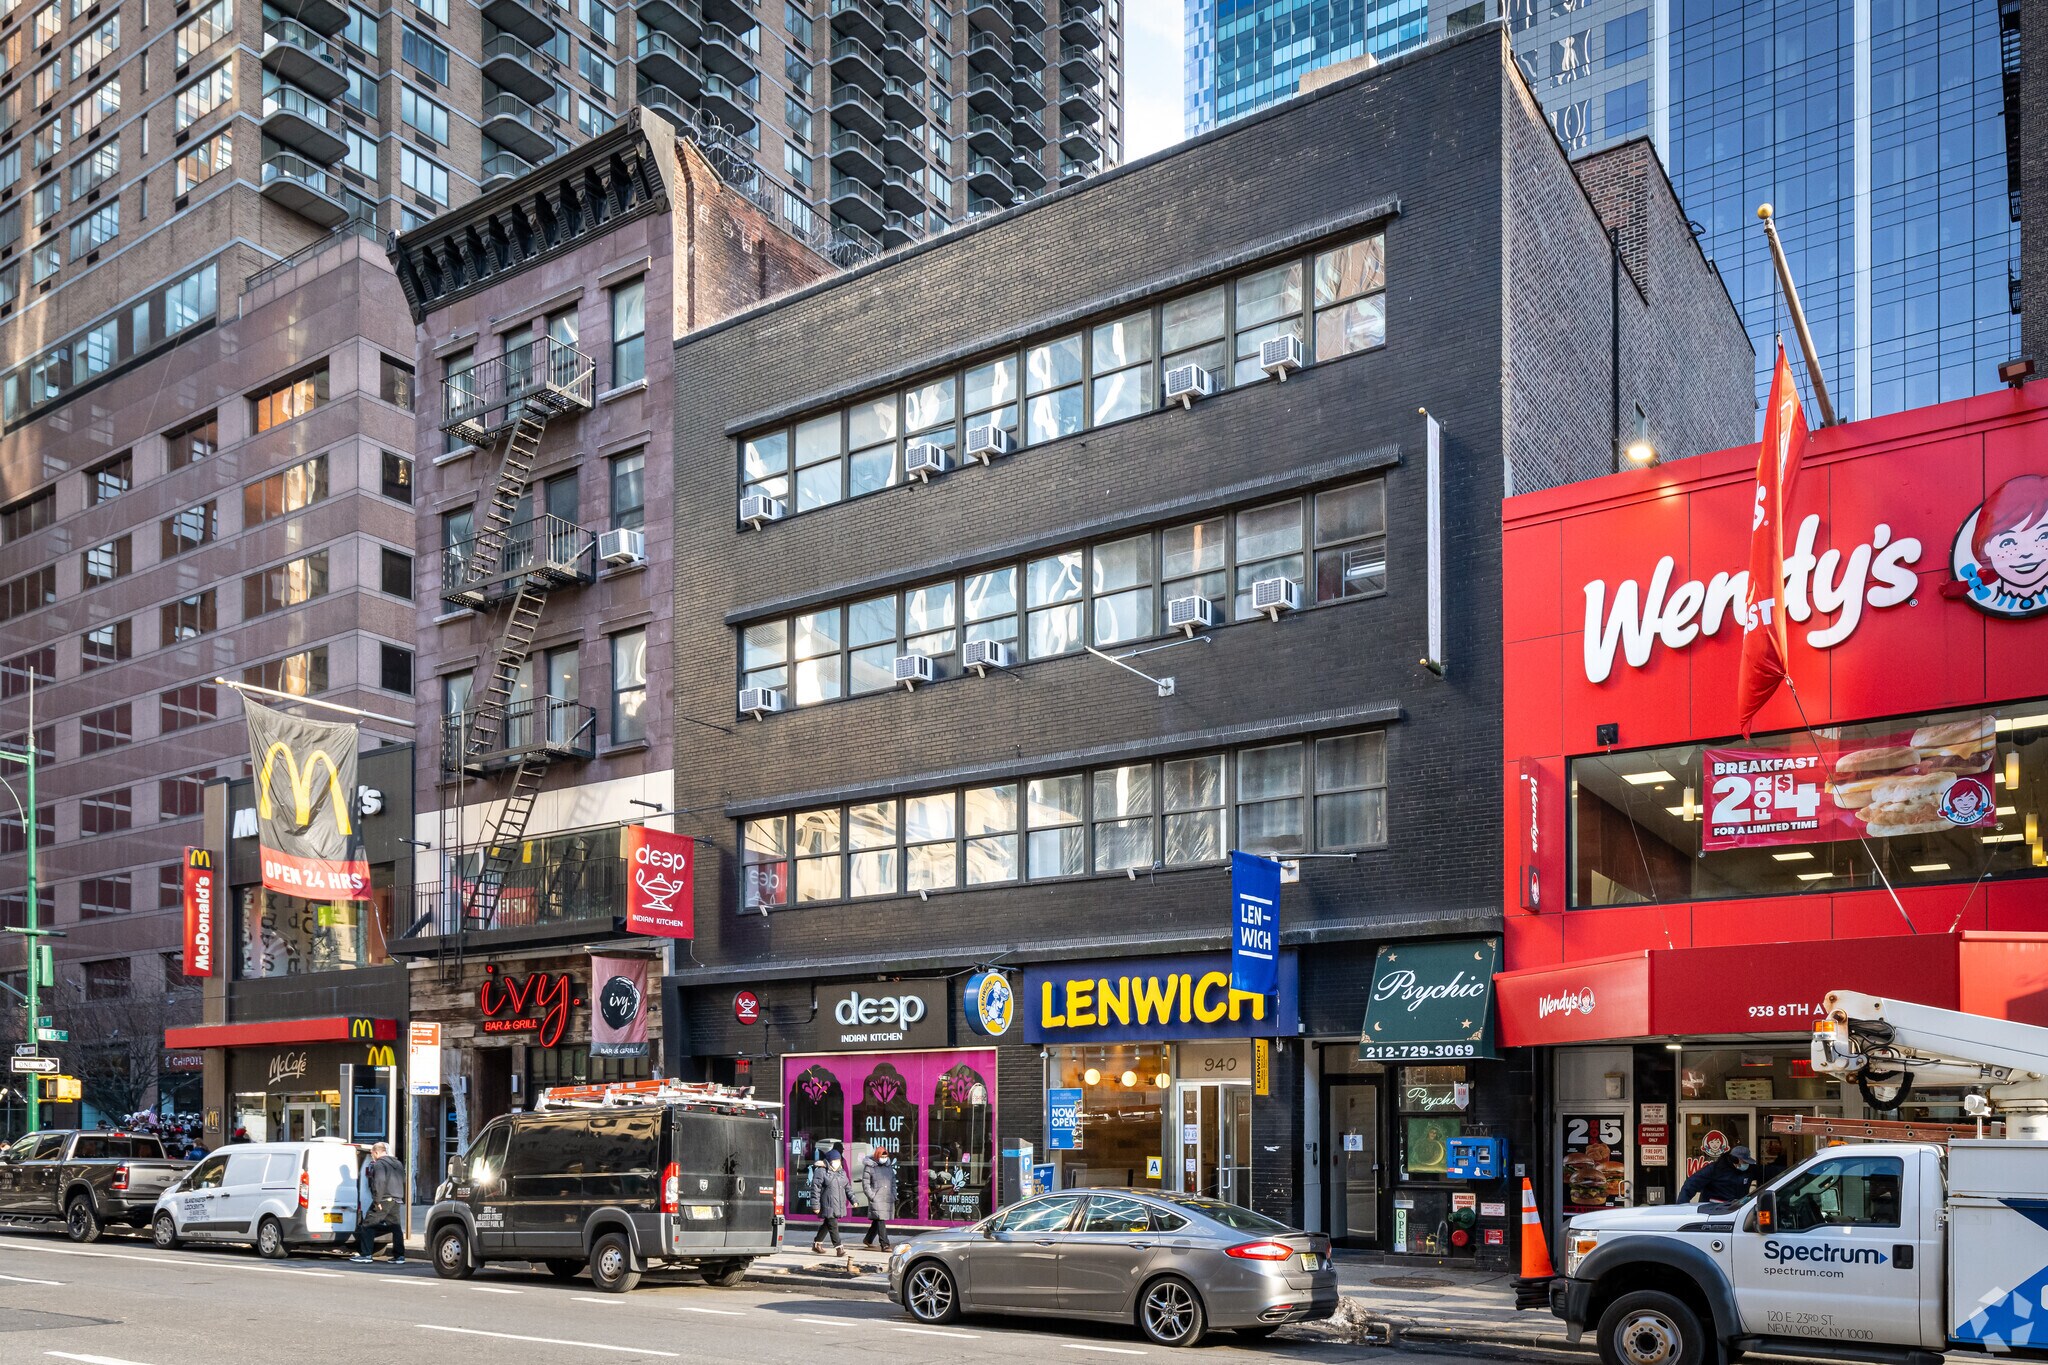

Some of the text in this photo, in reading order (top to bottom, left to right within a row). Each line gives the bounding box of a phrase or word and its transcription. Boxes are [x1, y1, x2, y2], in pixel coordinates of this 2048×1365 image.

[1583, 514, 1922, 684] Wendy's
[1713, 756, 1818, 775] BREAKFAST
[1712, 774, 1820, 824] 2 FOR $4
[1530, 776, 1539, 853] Wendy's
[1713, 820, 1818, 836] FOR A LIMITED TIME
[635, 843, 685, 874] deep
[265, 860, 364, 889] OPEN 24 HRS
[195, 876, 210, 971] McDonald's
[632, 915, 683, 927] INDIAN KITCHEN
[1240, 926, 1271, 951] WICH
[981, 980, 993, 1013] LENWICH
[1373, 970, 1485, 1012] Psychic
[1041, 971, 1265, 1028] LENWICH
[1539, 989, 1578, 1019] Wendy's
[835, 991, 925, 1031] deep
[1749, 1003, 1825, 1017] 938 8TH A
[485, 1019, 537, 1031] BAR & GRILL
[841, 1032, 903, 1043] INDIAN KITCHEN
[1366, 1044, 1475, 1058] 212-729-3069
[172, 1056, 204, 1066] CHIPOTL
[269, 1051, 307, 1083] McCafé
[1204, 1058, 1237, 1072] 940
[1052, 1108, 1075, 1118] NOW
[866, 1116, 905, 1132] ALL OF
[1052, 1118, 1076, 1127] OPEN
[1464, 1127, 1489, 1136] ATM
[1568, 1119, 1589, 1144] 2
[794, 1142, 801, 1150] A
[870, 1137, 900, 1153] INDIA
[1150, 1160, 1159, 1173] A
[942, 1194, 979, 1204] PLANT BASED
[949, 1205, 972, 1214] CHOICES
[1764, 1240, 1879, 1265] Spectrum
[1764, 1267, 1844, 1279] spectrum.com
[1767, 1311, 1835, 1326] 120 E. 23RD ST.
[1767, 1323, 1874, 1340] NEW YORK, NY 10010
